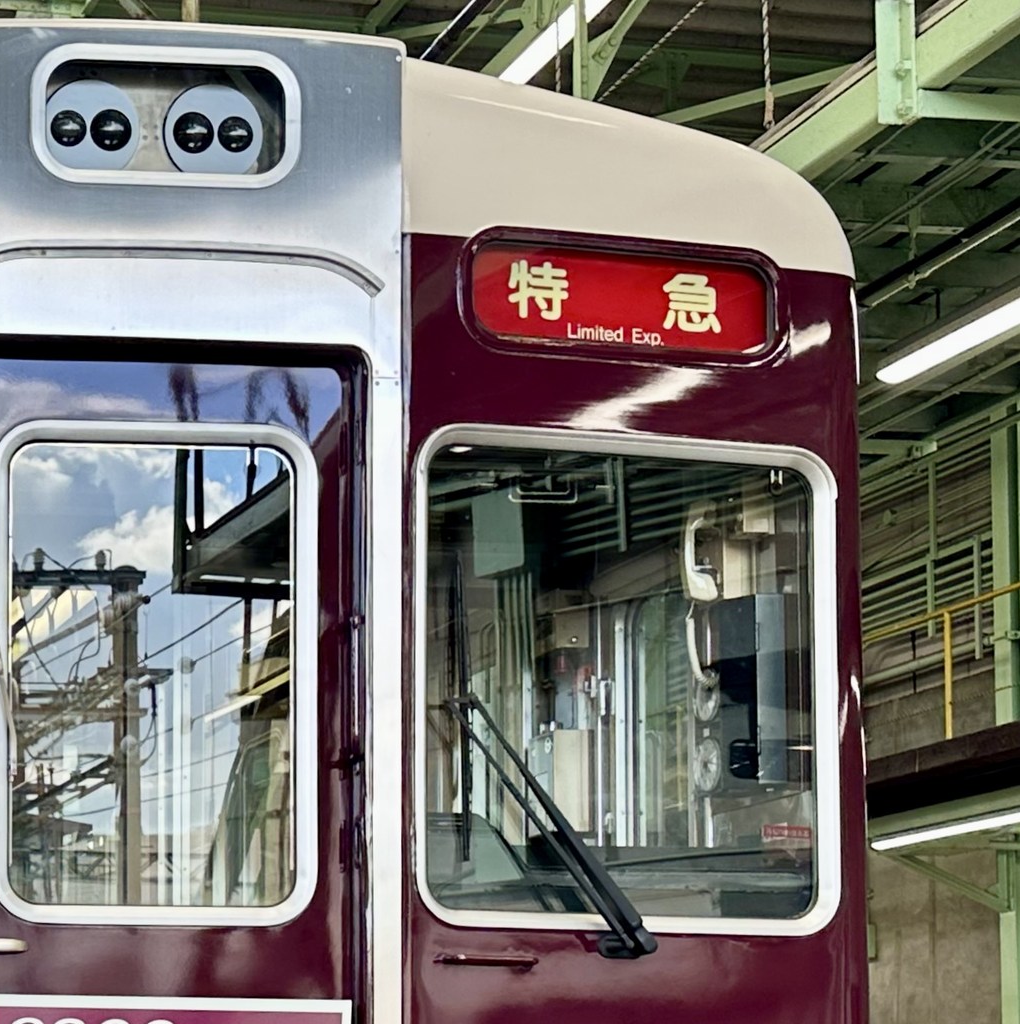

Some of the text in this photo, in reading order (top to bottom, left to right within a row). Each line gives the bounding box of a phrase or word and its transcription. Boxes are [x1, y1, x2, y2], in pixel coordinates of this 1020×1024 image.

[508, 259, 722, 334] 特急
[567, 323, 665, 347] Limited Exp.
